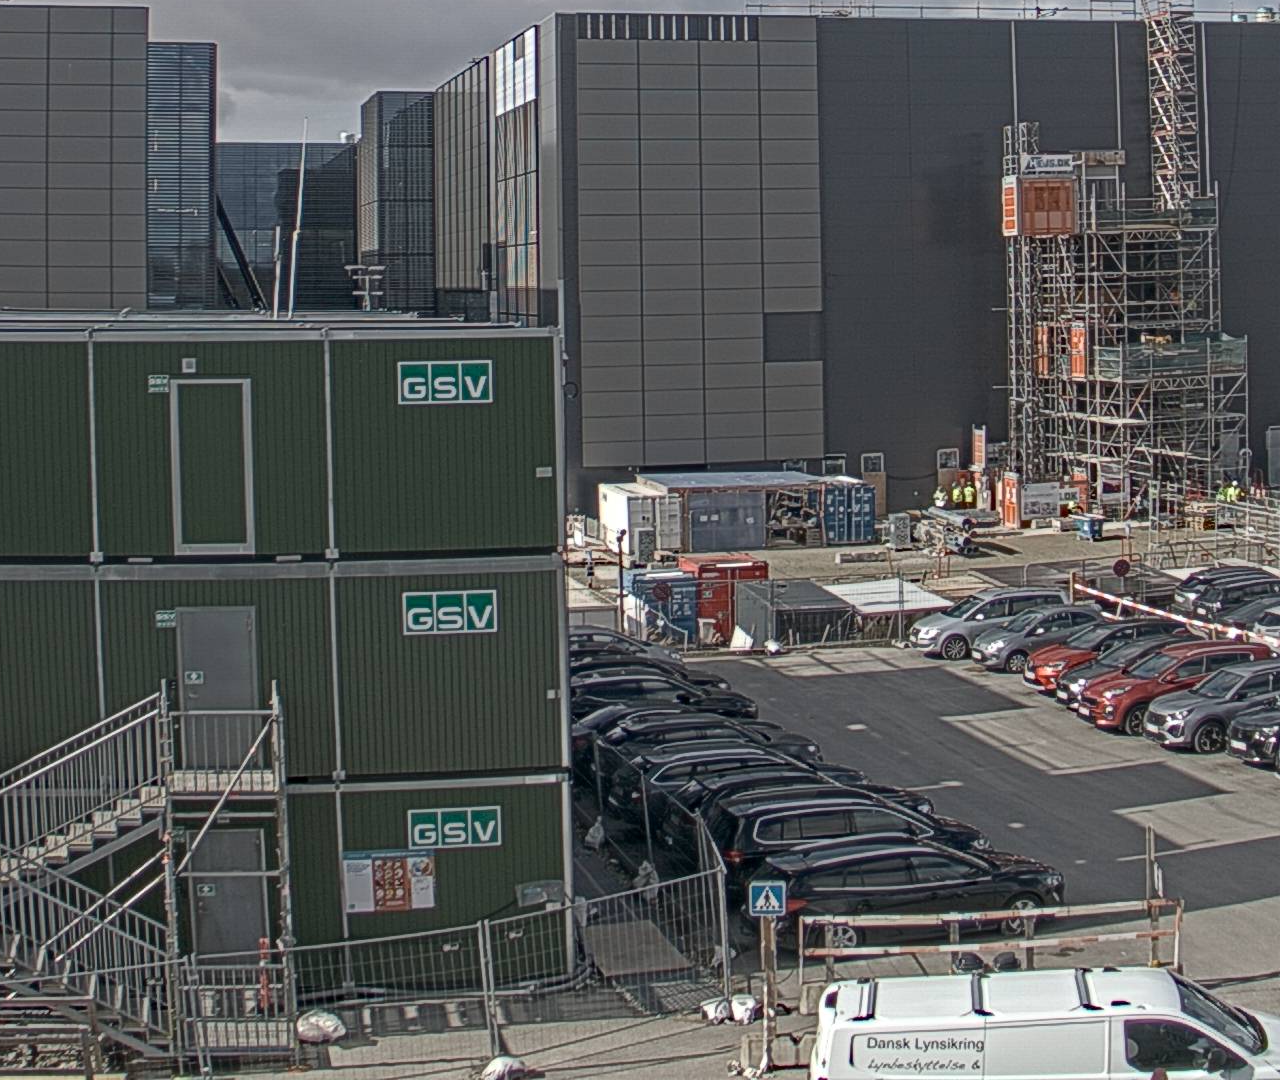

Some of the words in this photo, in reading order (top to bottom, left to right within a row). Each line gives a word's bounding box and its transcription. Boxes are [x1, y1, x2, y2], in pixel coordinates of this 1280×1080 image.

[401, 374, 488, 401] GSV
[406, 604, 493, 632] GSV
[412, 820, 496, 844] GSV
[866, 1036, 911, 1049] Dansk
[915, 1036, 985, 1052] Lynsikring
[867, 1057, 966, 1074] Lynbeskyttelse
